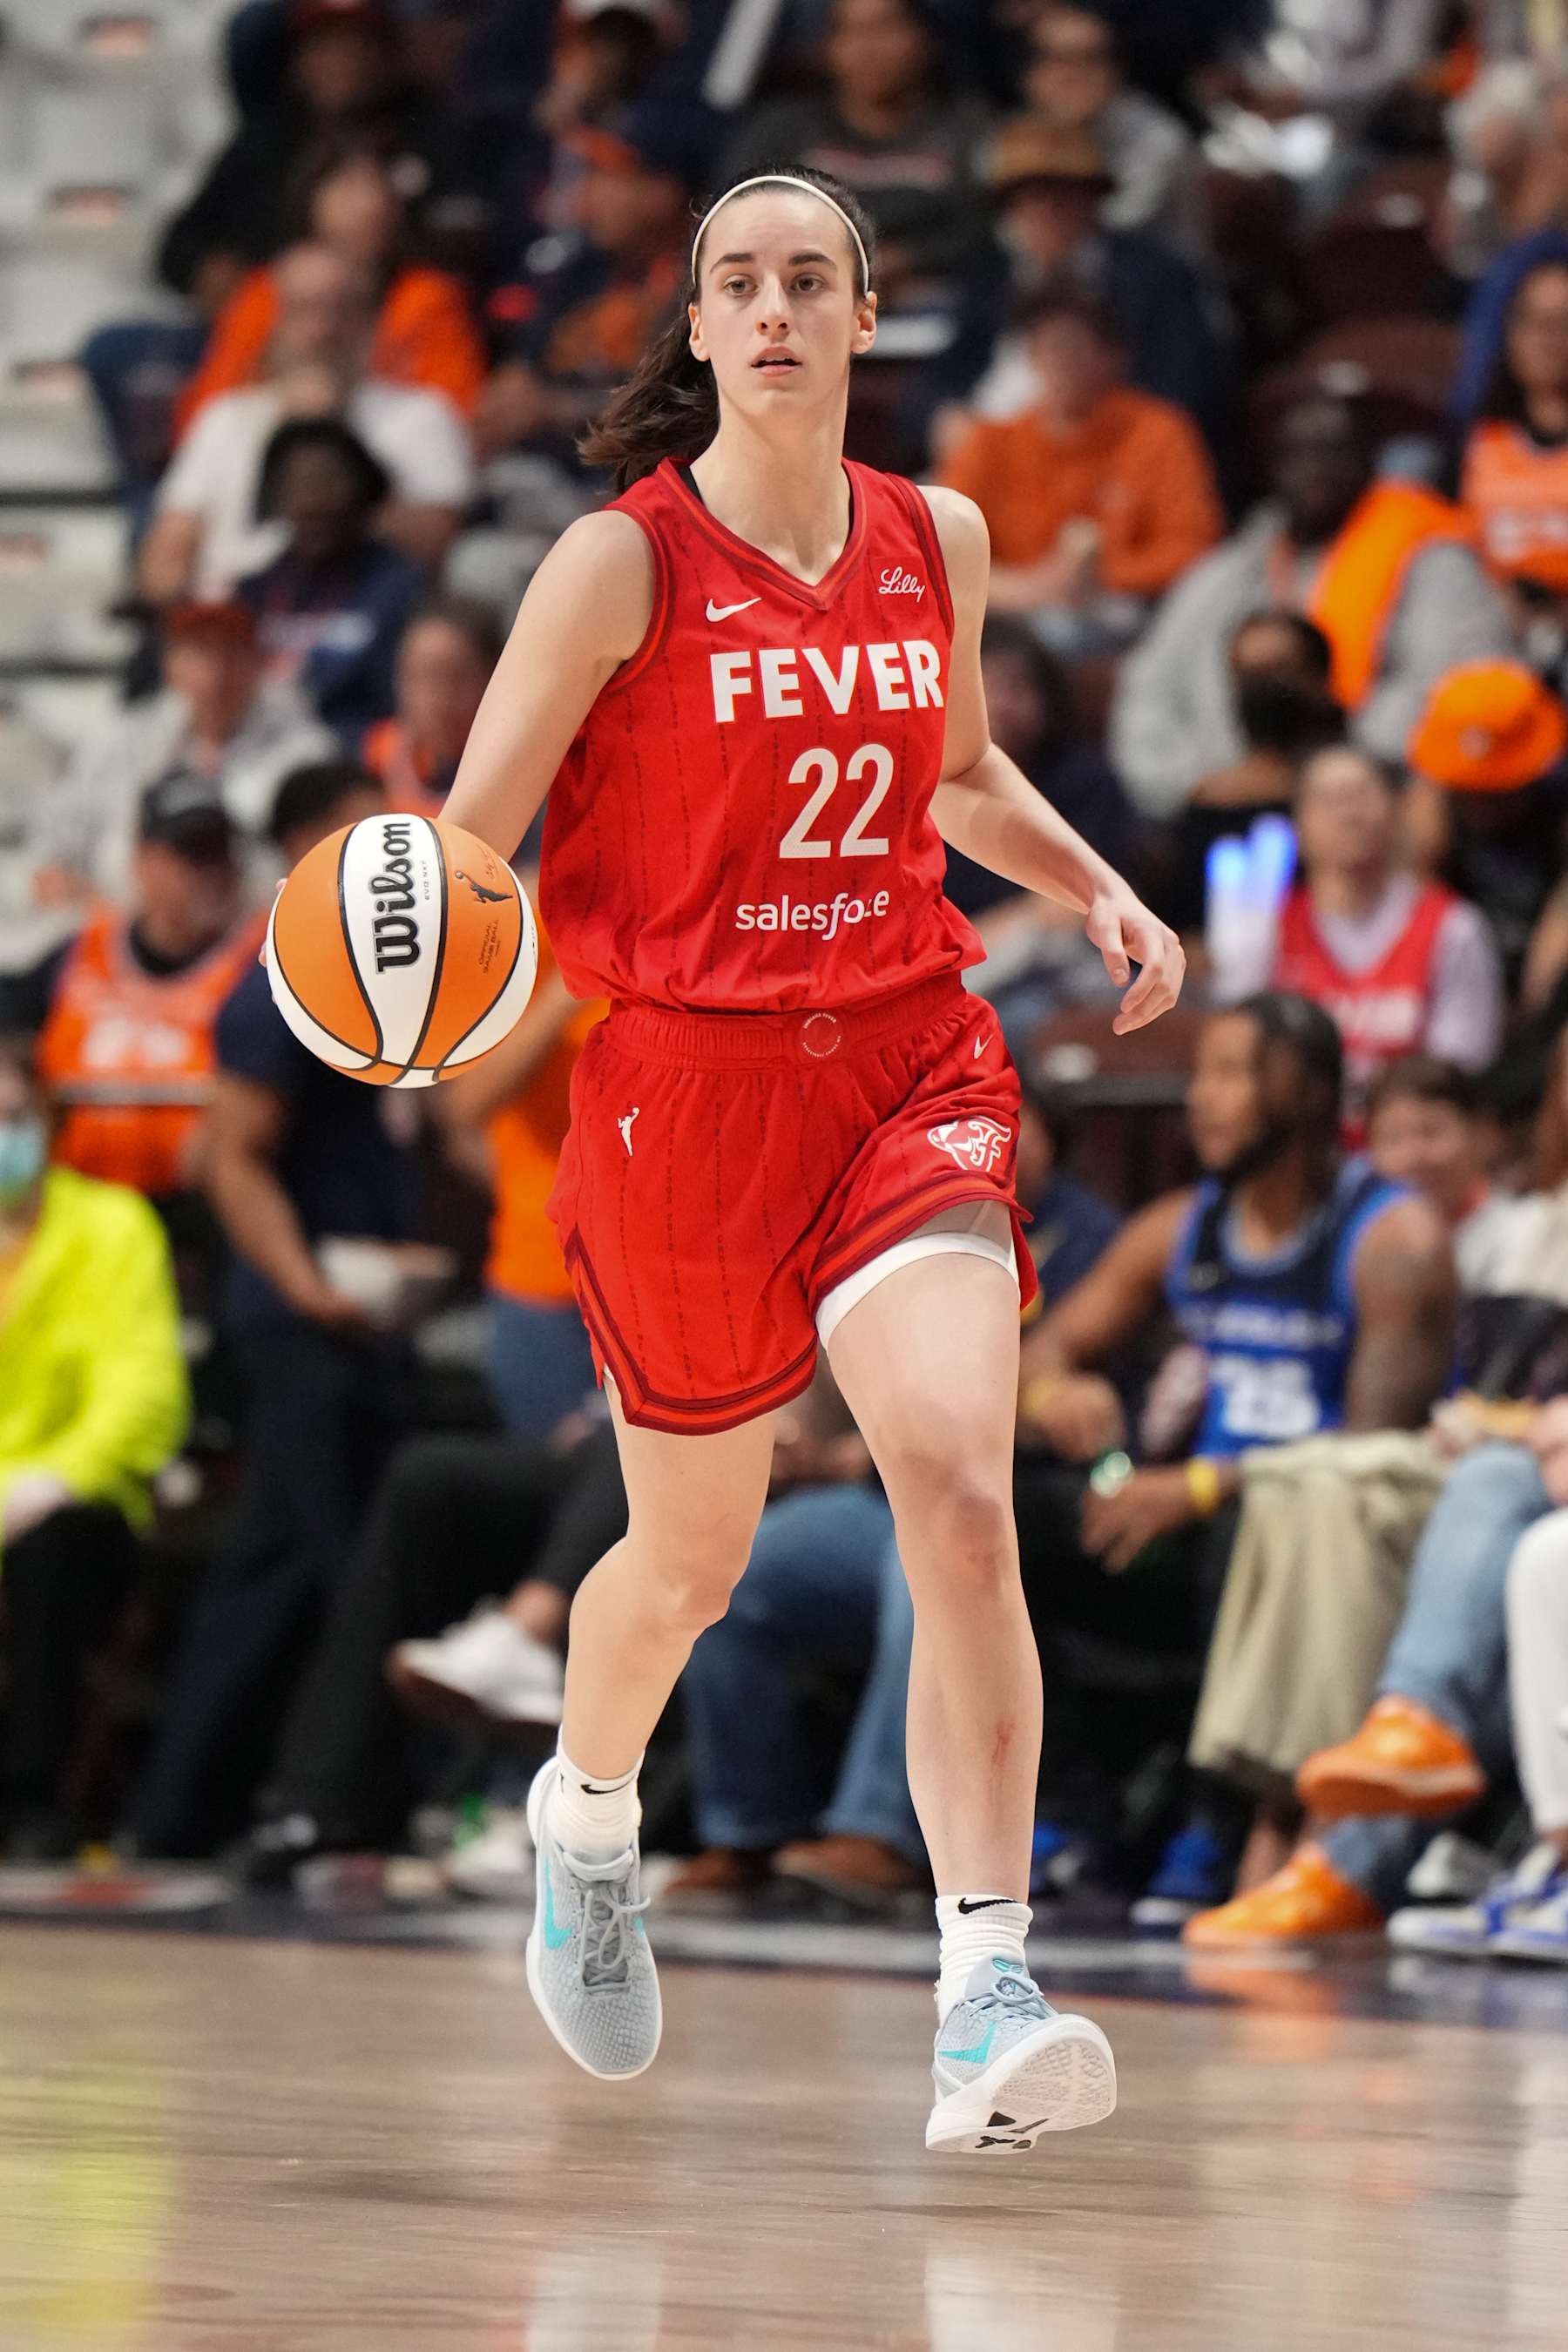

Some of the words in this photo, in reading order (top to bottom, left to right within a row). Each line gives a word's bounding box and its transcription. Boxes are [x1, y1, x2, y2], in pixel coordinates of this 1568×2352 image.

[878, 566, 925, 602] Lilly
[710, 639, 944, 724] FEVER
[779, 743, 894, 859] 22
[370, 822, 421, 975] Wilson
[490, 919, 499, 943] BALL
[734, 889, 889, 941] salesfoe
